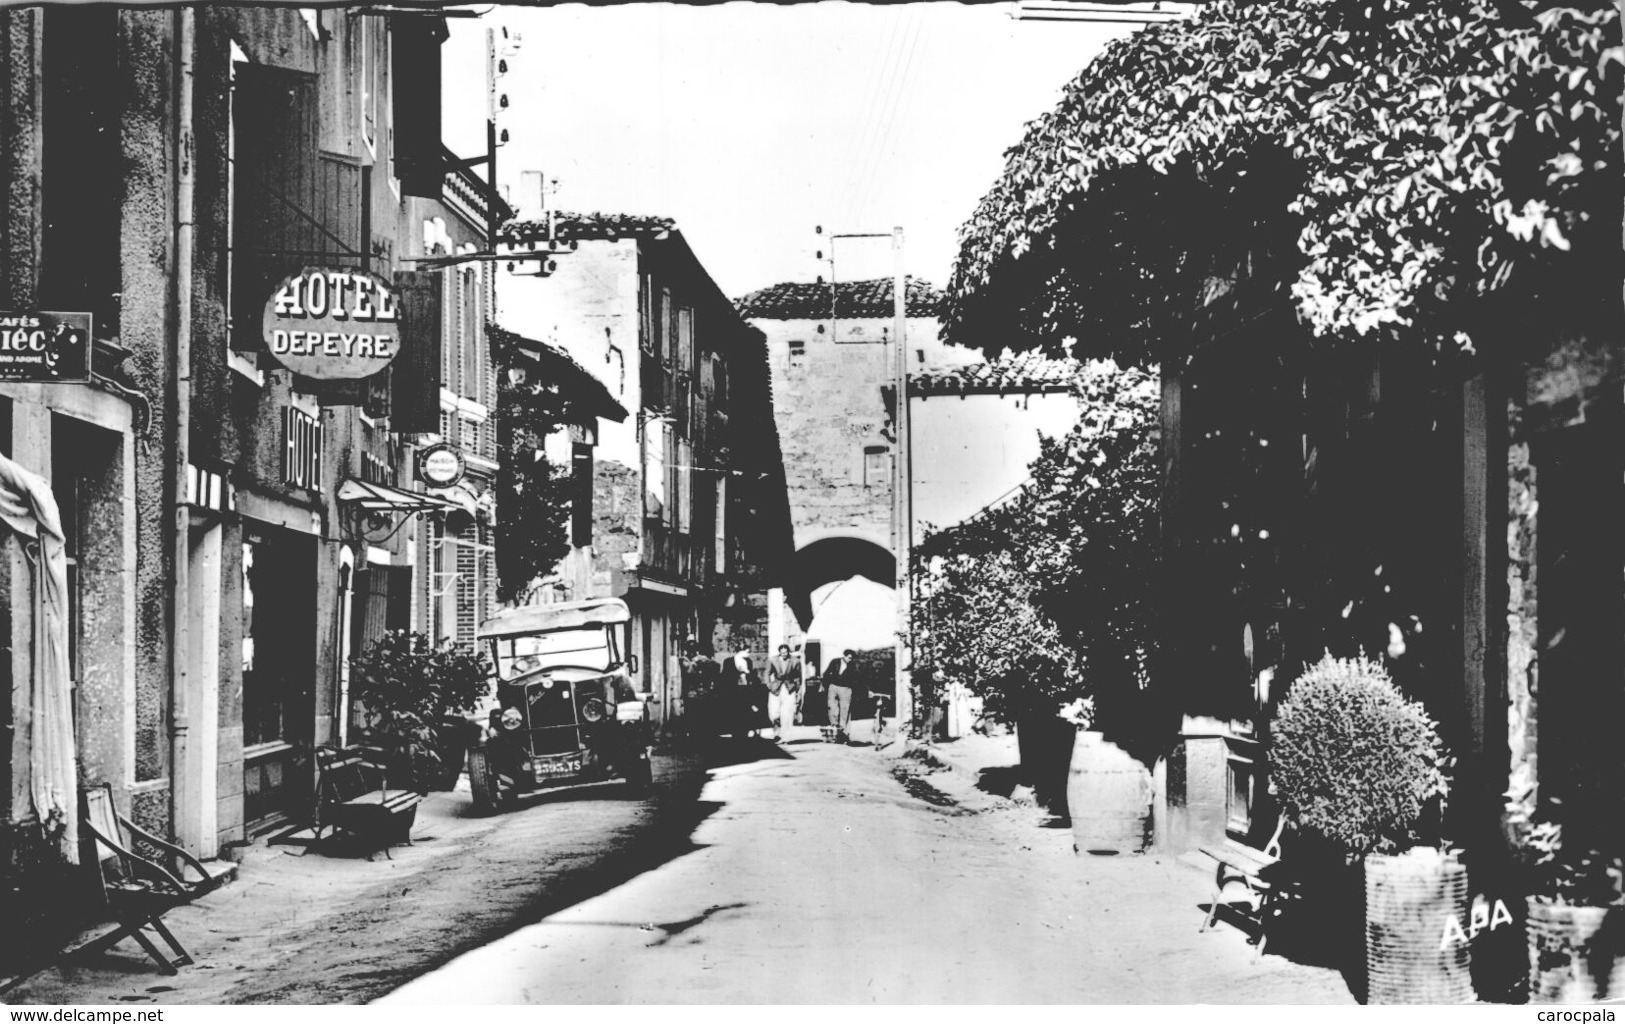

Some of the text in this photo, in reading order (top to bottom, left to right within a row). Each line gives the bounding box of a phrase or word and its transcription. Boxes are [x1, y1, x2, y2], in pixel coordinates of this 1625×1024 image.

[274, 272, 396, 320] HOTEL
[273, 329, 391, 357] DEPEYRE
[286, 406, 325, 493] HOTEL
